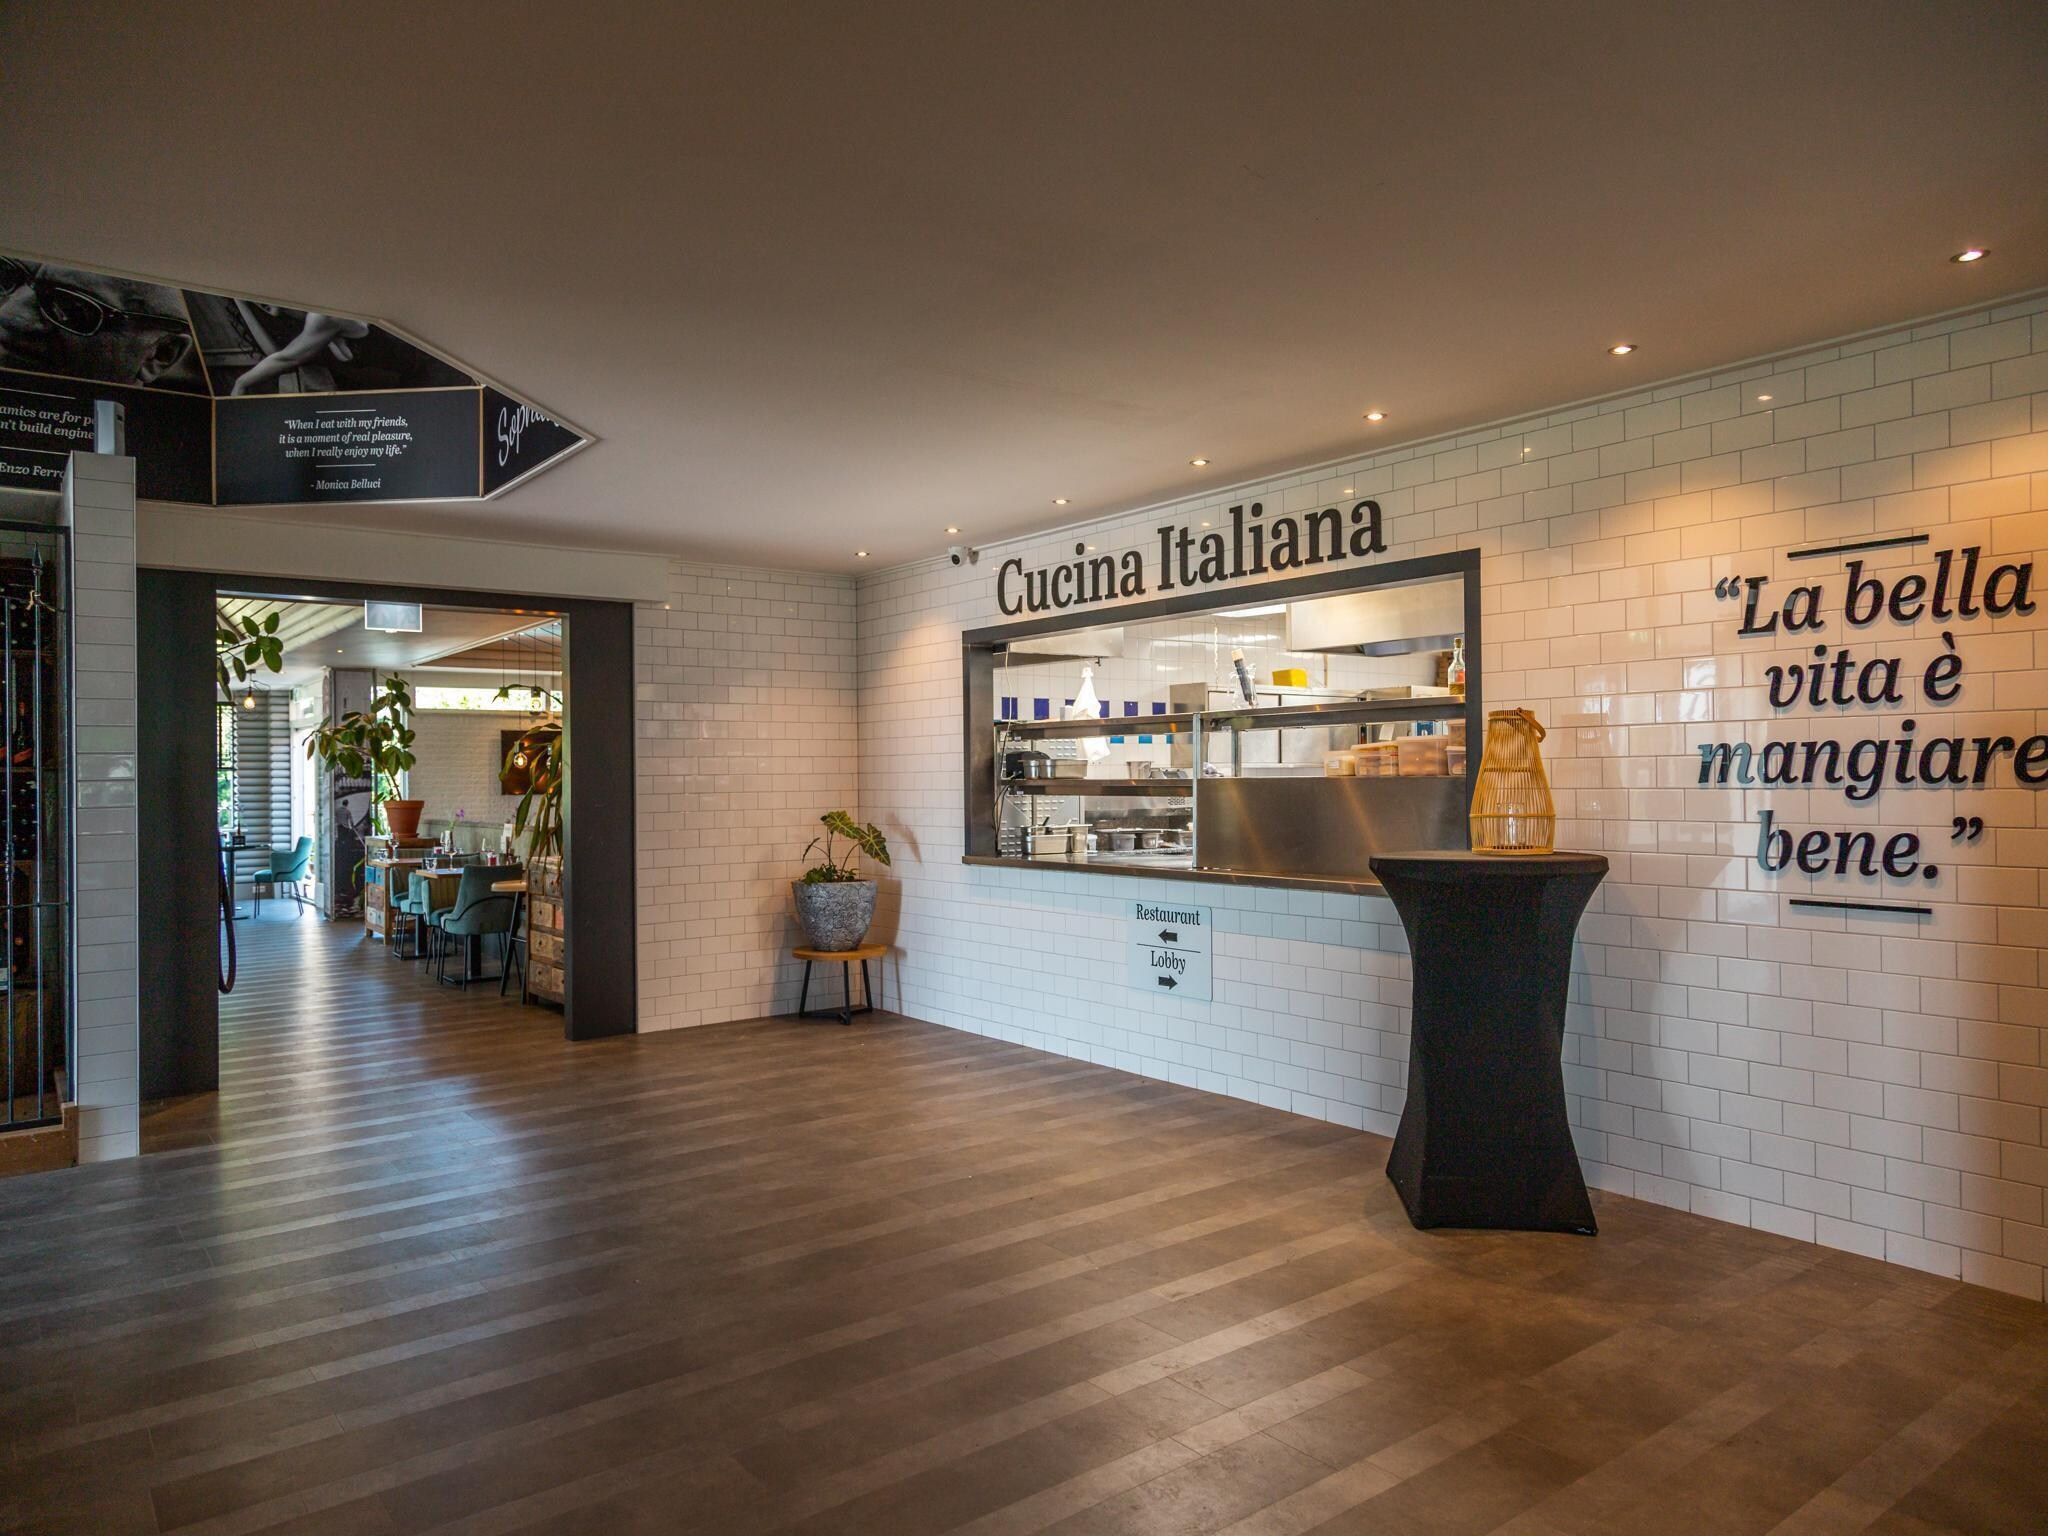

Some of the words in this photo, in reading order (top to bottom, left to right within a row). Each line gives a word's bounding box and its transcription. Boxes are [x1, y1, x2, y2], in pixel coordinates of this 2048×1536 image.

[39, 410, 60, 420] are
[60, 411, 82, 424] for
[315, 419, 320, 429] I
[321, 419, 335, 429] eat
[336, 418, 357, 429] with
[358, 420, 372, 430] my
[371, 416, 408, 429] friends,
[20, 421, 52, 435] build
[279, 433, 286, 444] it
[287, 433, 296, 444] is
[304, 434, 340, 443] moment
[341, 432, 352, 444] of
[352, 431, 371, 442] real
[371, 431, 413, 444] pleasure,
[285, 447, 310, 458] when
[317, 446, 343, 458] really
[344, 446, 369, 458] enjoy
[370, 447, 384, 457] my
[0, 462, 30, 475] Enzo
[316, 480, 349, 490] Monica
[351, 478, 381, 489] Belluci
[998, 543, 1146, 616] Cucina
[1157, 500, 1388, 591] Italiana
[1715, 575, 1825, 636] “La
[1844, 545, 2037, 626] bella
[1765, 644, 1904, 709] vita
[1923, 631, 1964, 702] è
[1697, 719, 2048, 801] mangiare
[1136, 903, 1201, 926] Restaurant
[1150, 950, 1186, 975] Lobby
